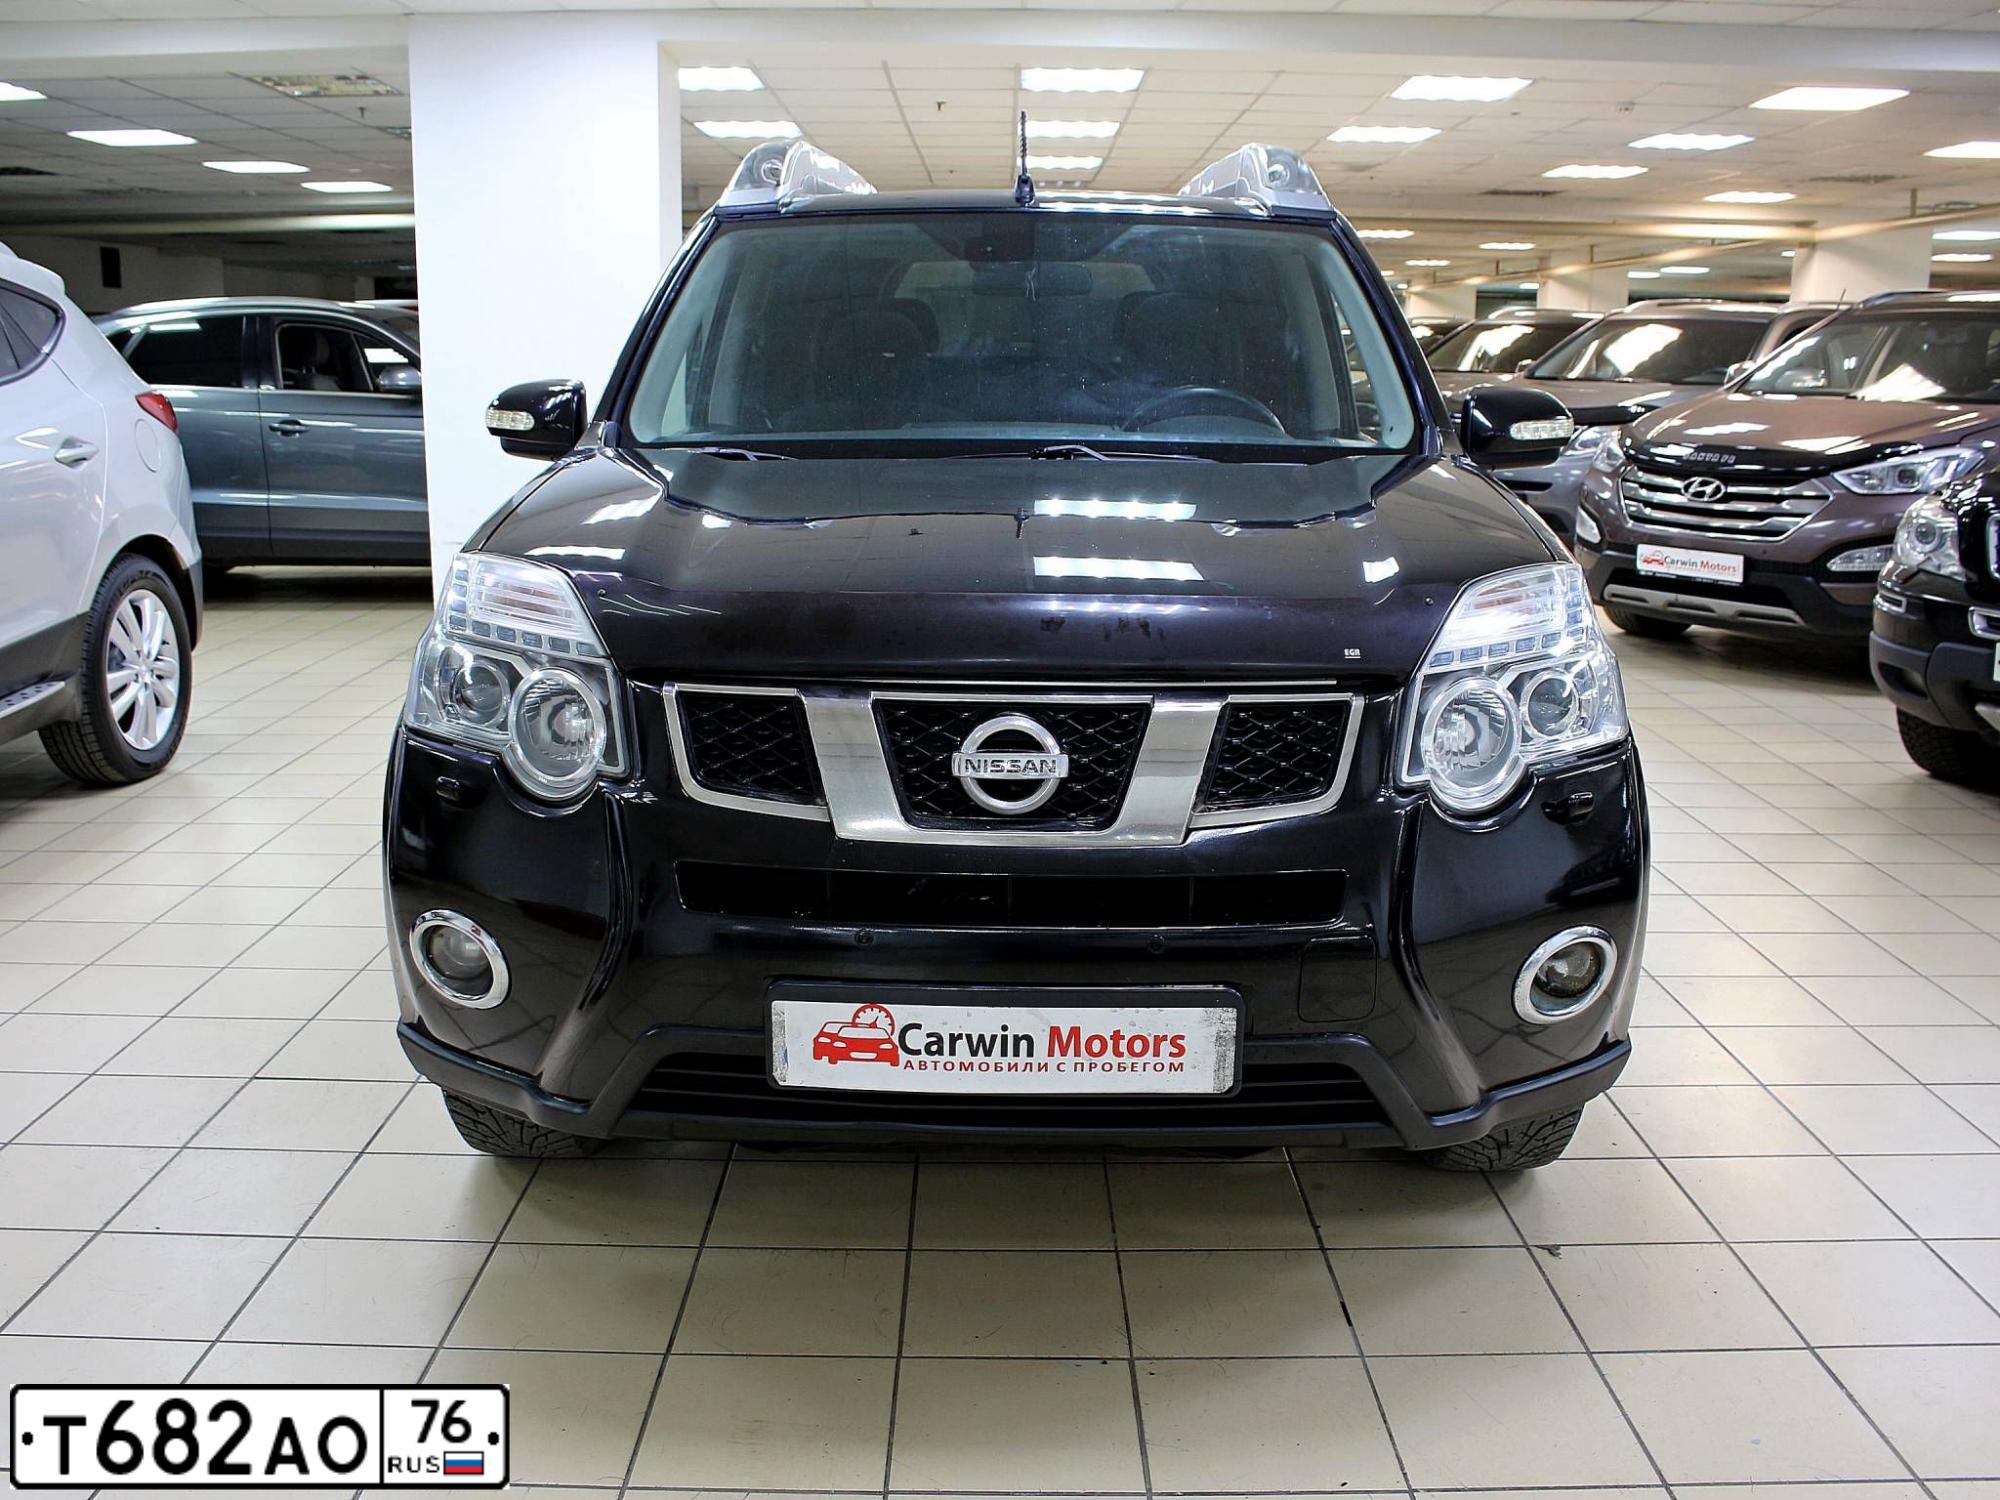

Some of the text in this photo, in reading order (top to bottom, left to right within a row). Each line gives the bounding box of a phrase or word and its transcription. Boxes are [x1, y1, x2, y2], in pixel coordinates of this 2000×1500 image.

[1664, 555, 1698, 568] Carwin
[1700, 560, 1737, 573] Motors
[965, 758, 1056, 774] NISSAN
[898, 1022, 1186, 1058] Carwin Motors
[903, 1060, 1184, 1073] АВТОМОБИЛИ С ПРОБЕГОМ
